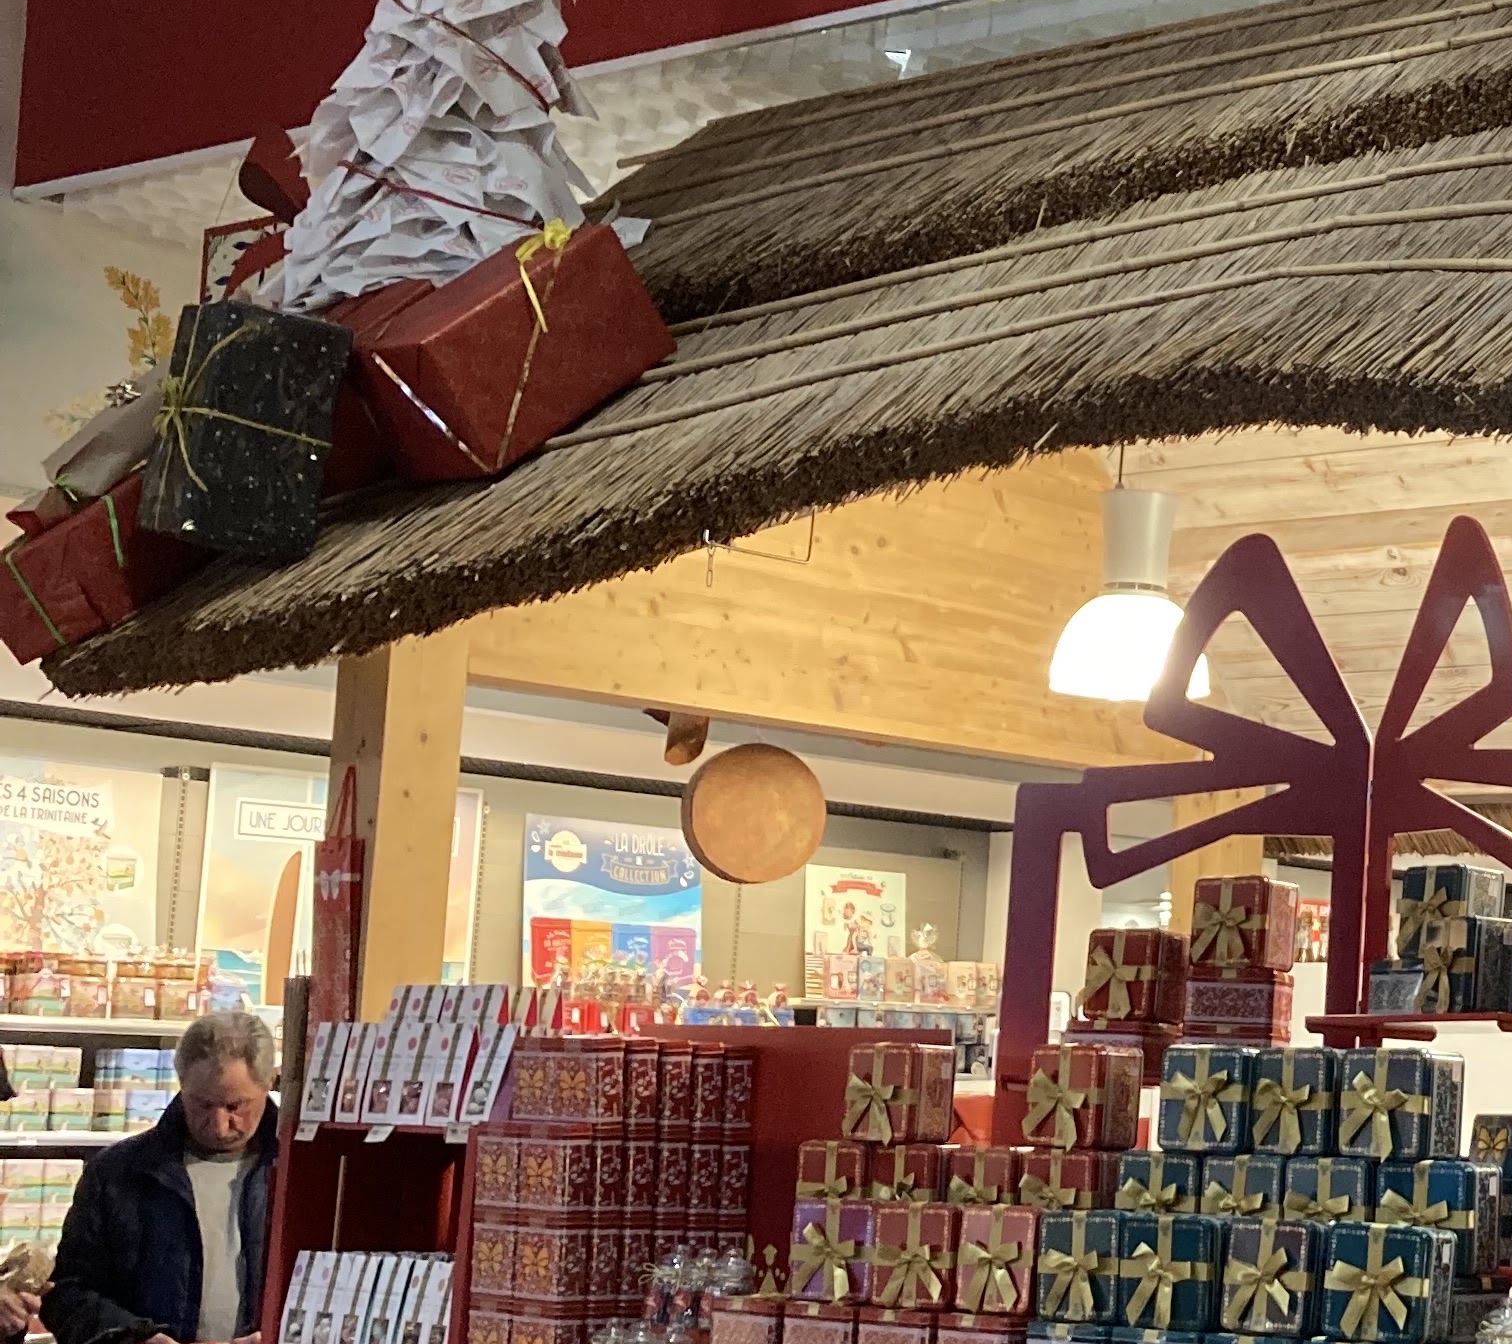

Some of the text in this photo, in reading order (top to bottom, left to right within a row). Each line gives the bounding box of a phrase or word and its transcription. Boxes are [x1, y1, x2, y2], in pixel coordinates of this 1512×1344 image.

[17, 786, 26, 802] 4
[31, 786, 100, 808] SAISONS
[13, 806, 27, 818] LA
[31, 807, 88, 824] TRINITAINE
[249, 811, 277, 830] UNE
[615, 833, 628, 853] LA
[614, 866, 667, 883] COLLECTION
